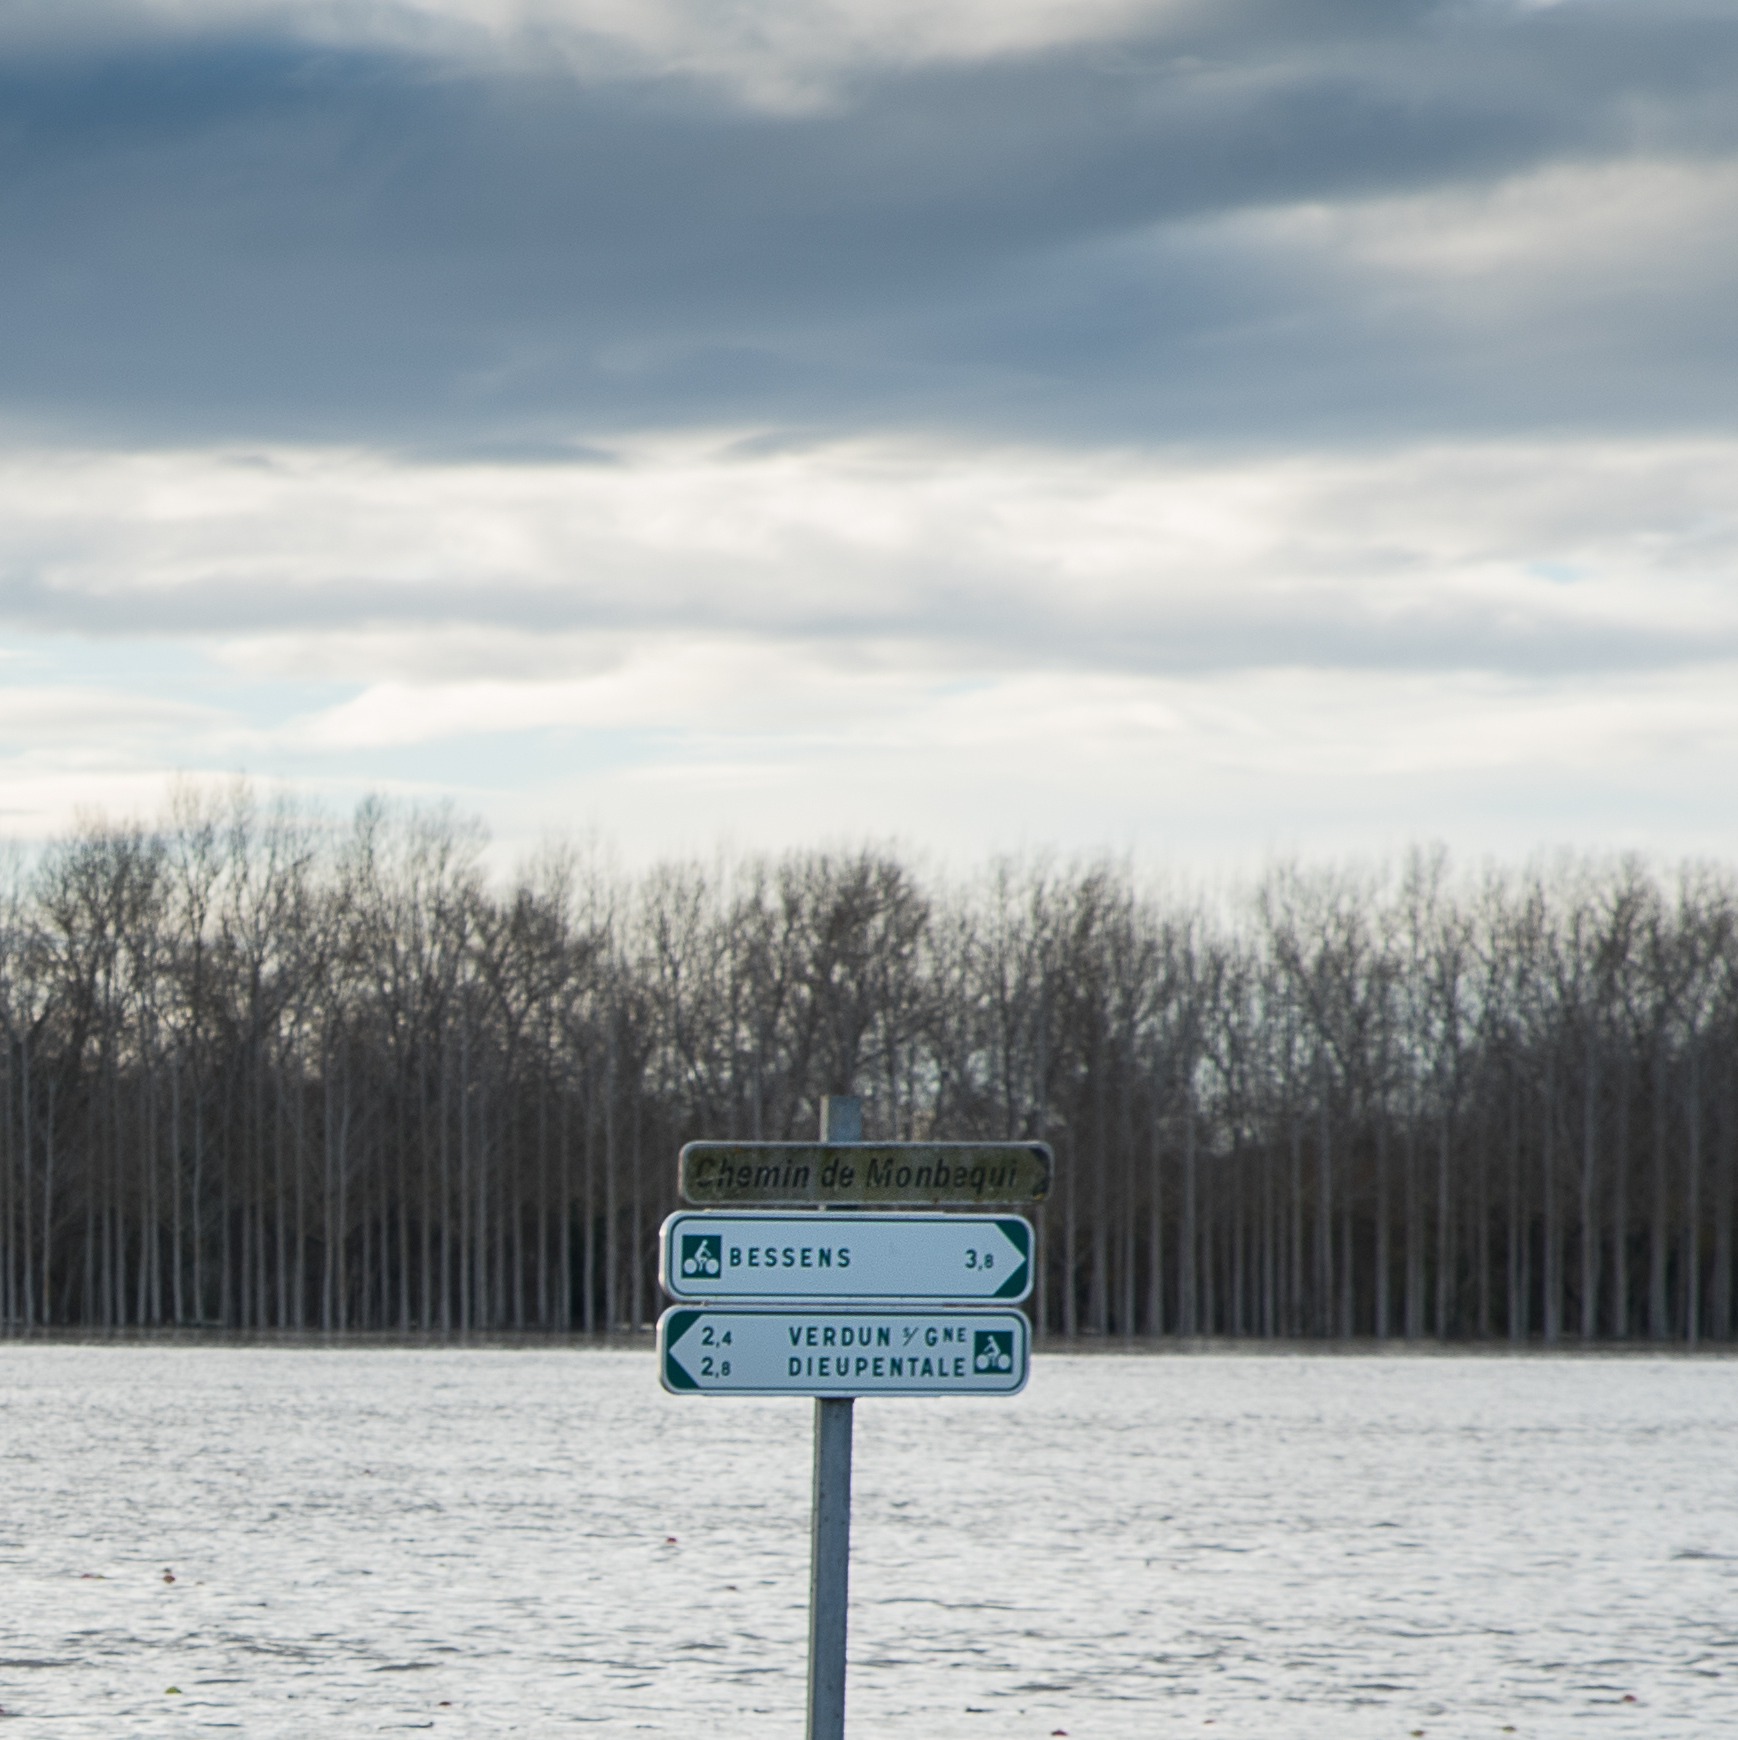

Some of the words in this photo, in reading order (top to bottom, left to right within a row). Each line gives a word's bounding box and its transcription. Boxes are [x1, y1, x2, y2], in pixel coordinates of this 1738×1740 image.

[695, 1157, 810, 1188] Chemin
[821, 1158, 855, 1188] de
[729, 1247, 851, 1268] BESSENS
[965, 1249, 994, 1270] 3,8
[701, 1326, 732, 1348] 2,4
[788, 1326, 891, 1347] VERDUN
[701, 1356, 731, 1378] 2,8
[788, 1356, 966, 1377] DIEUPENTALE
